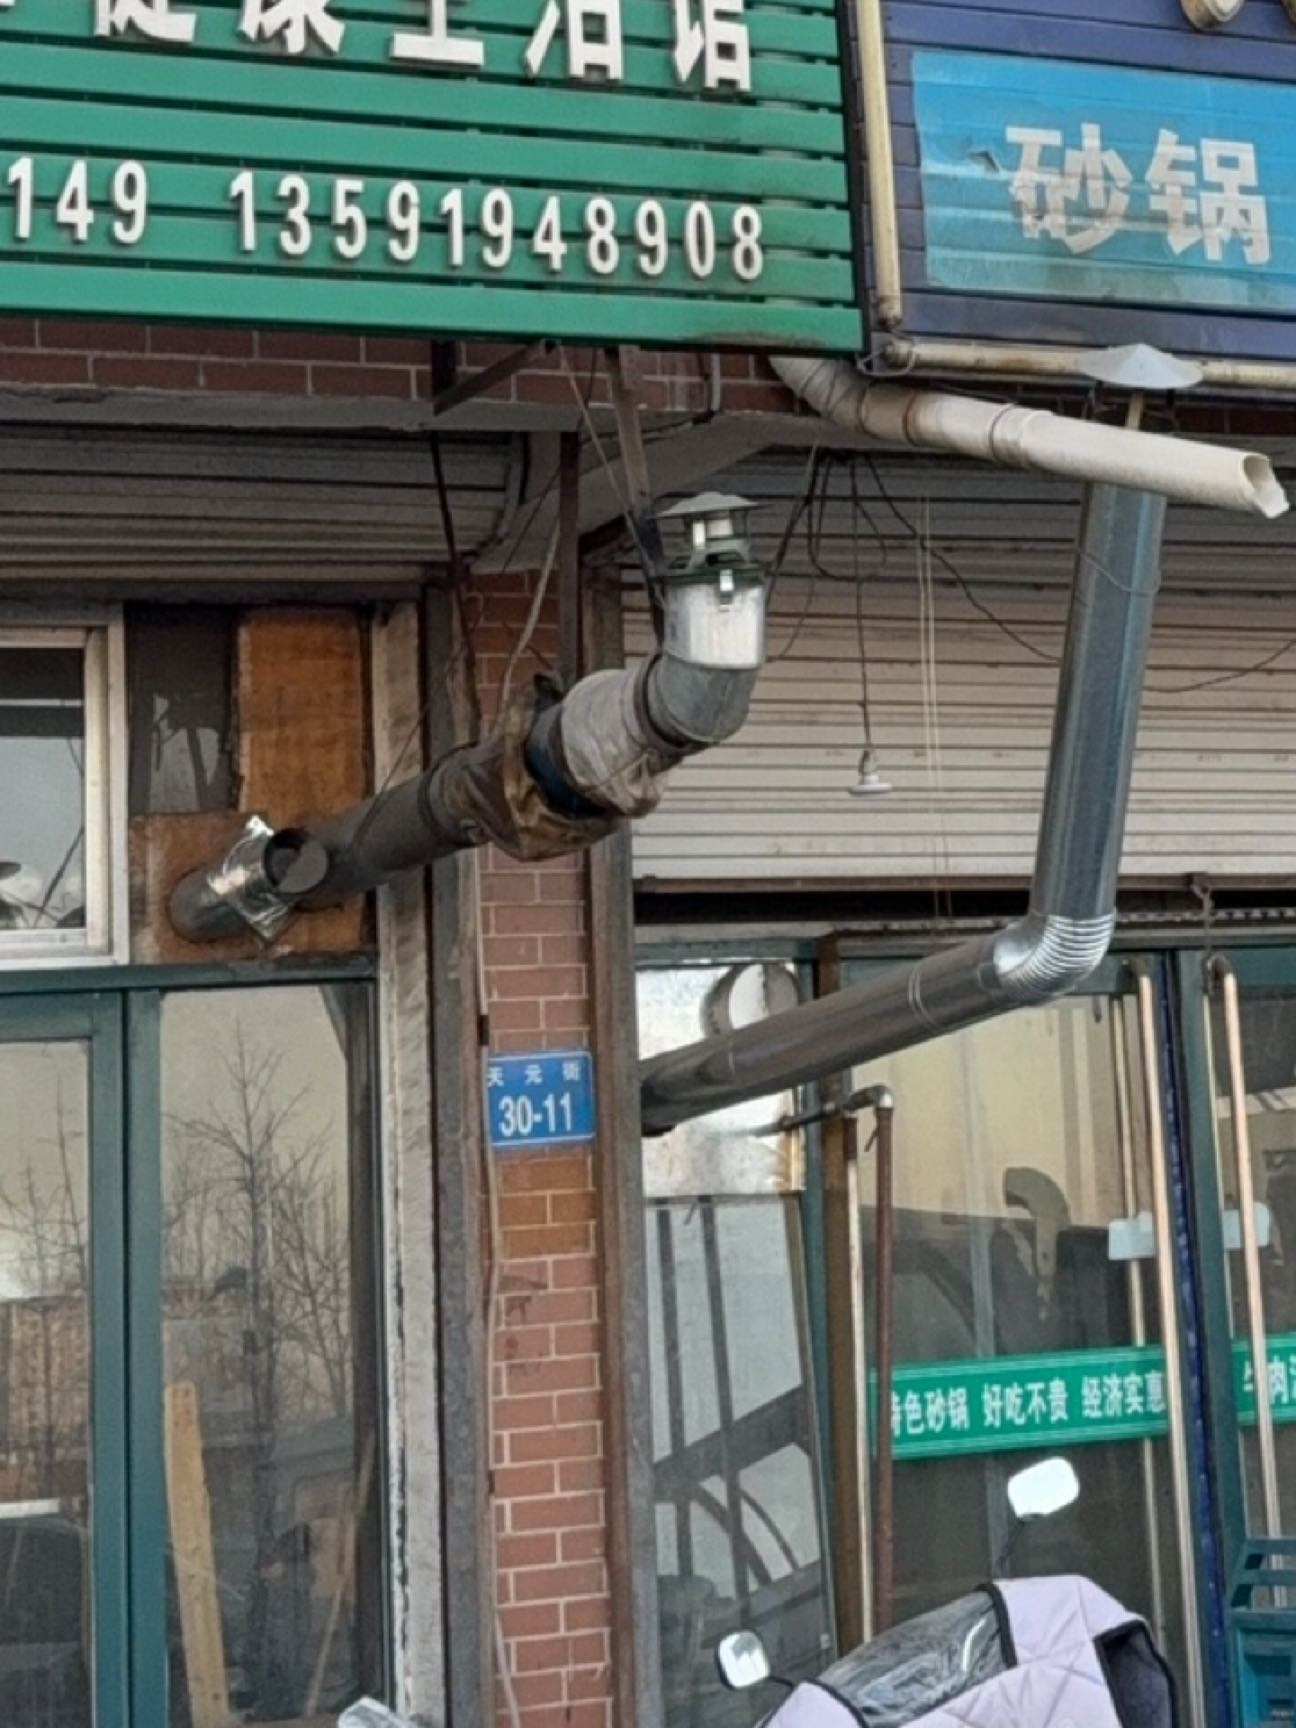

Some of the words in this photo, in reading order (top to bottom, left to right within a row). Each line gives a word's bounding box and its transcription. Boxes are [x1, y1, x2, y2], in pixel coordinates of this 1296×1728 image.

[7, 156, 149, 245] 149
[230, 169, 764, 282] 13591948908
[1005, 122, 1272, 265] 砂锅
[498, 1093, 572, 1137] 30-11
